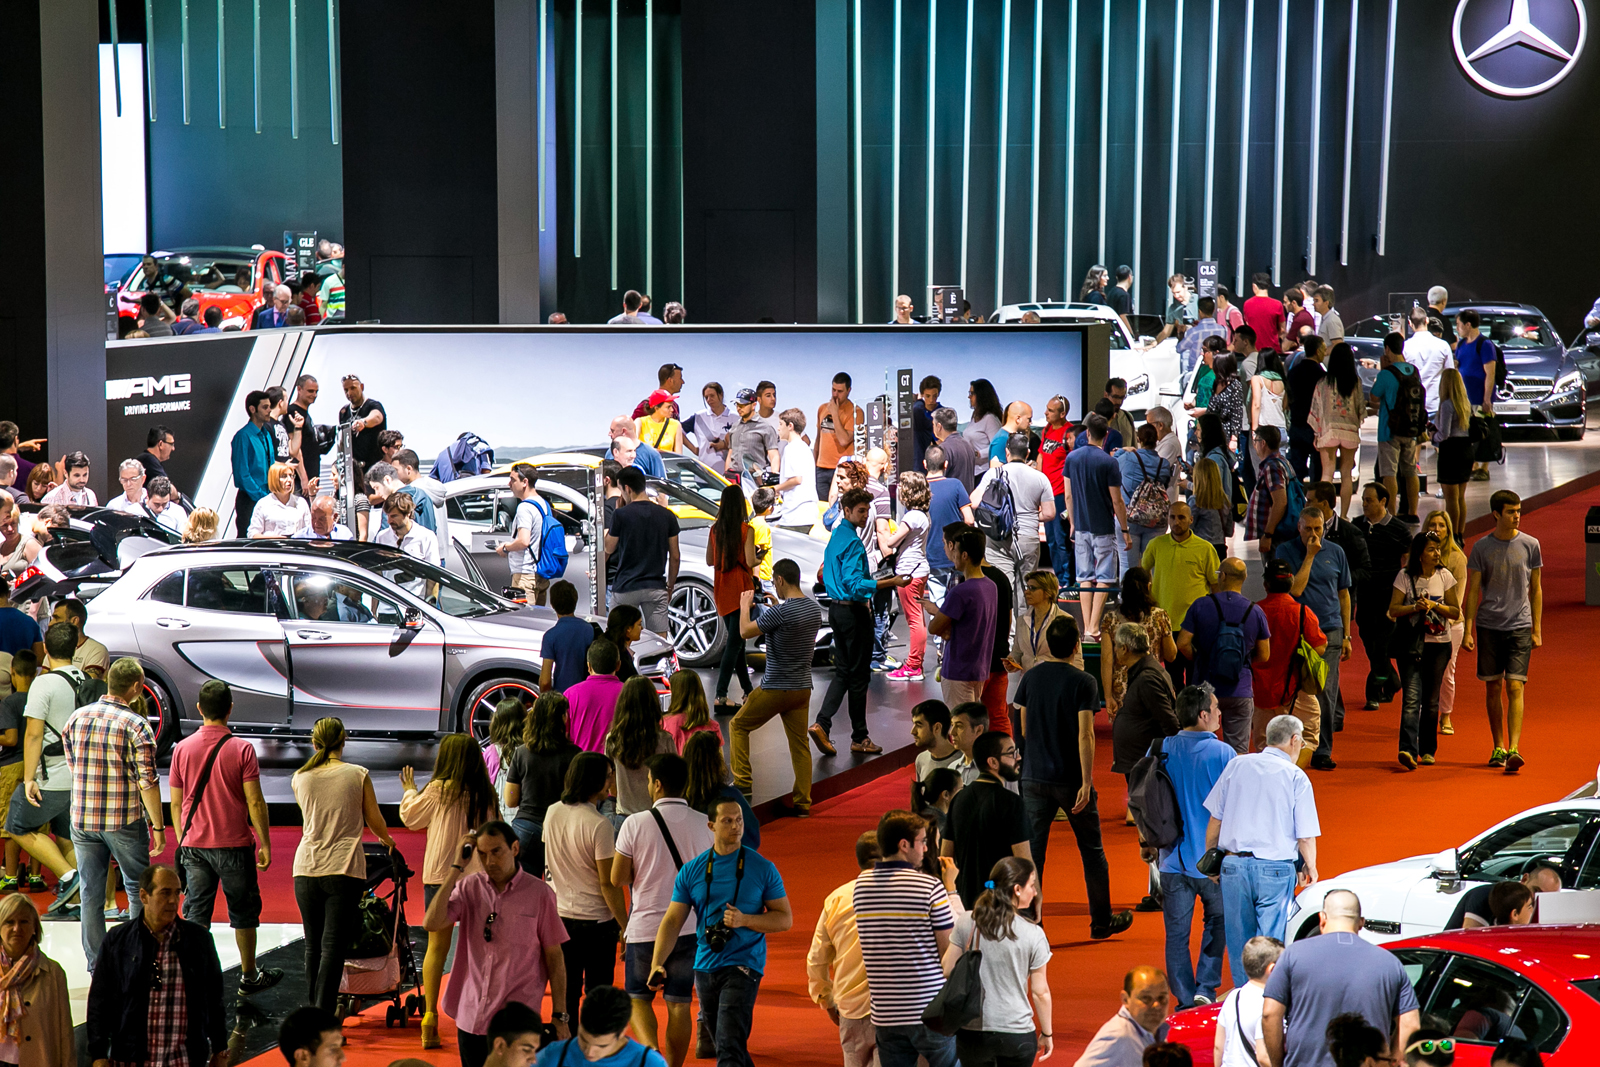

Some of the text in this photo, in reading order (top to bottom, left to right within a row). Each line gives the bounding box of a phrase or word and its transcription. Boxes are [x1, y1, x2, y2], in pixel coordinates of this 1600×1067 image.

[299, 237, 315, 248] GLE
[1200, 265, 1216, 276] CLS
[122, 373, 191, 398] AMG
[900, 374, 910, 387] GT
[124, 400, 191, 416] DRIVING PERFORMANCE
